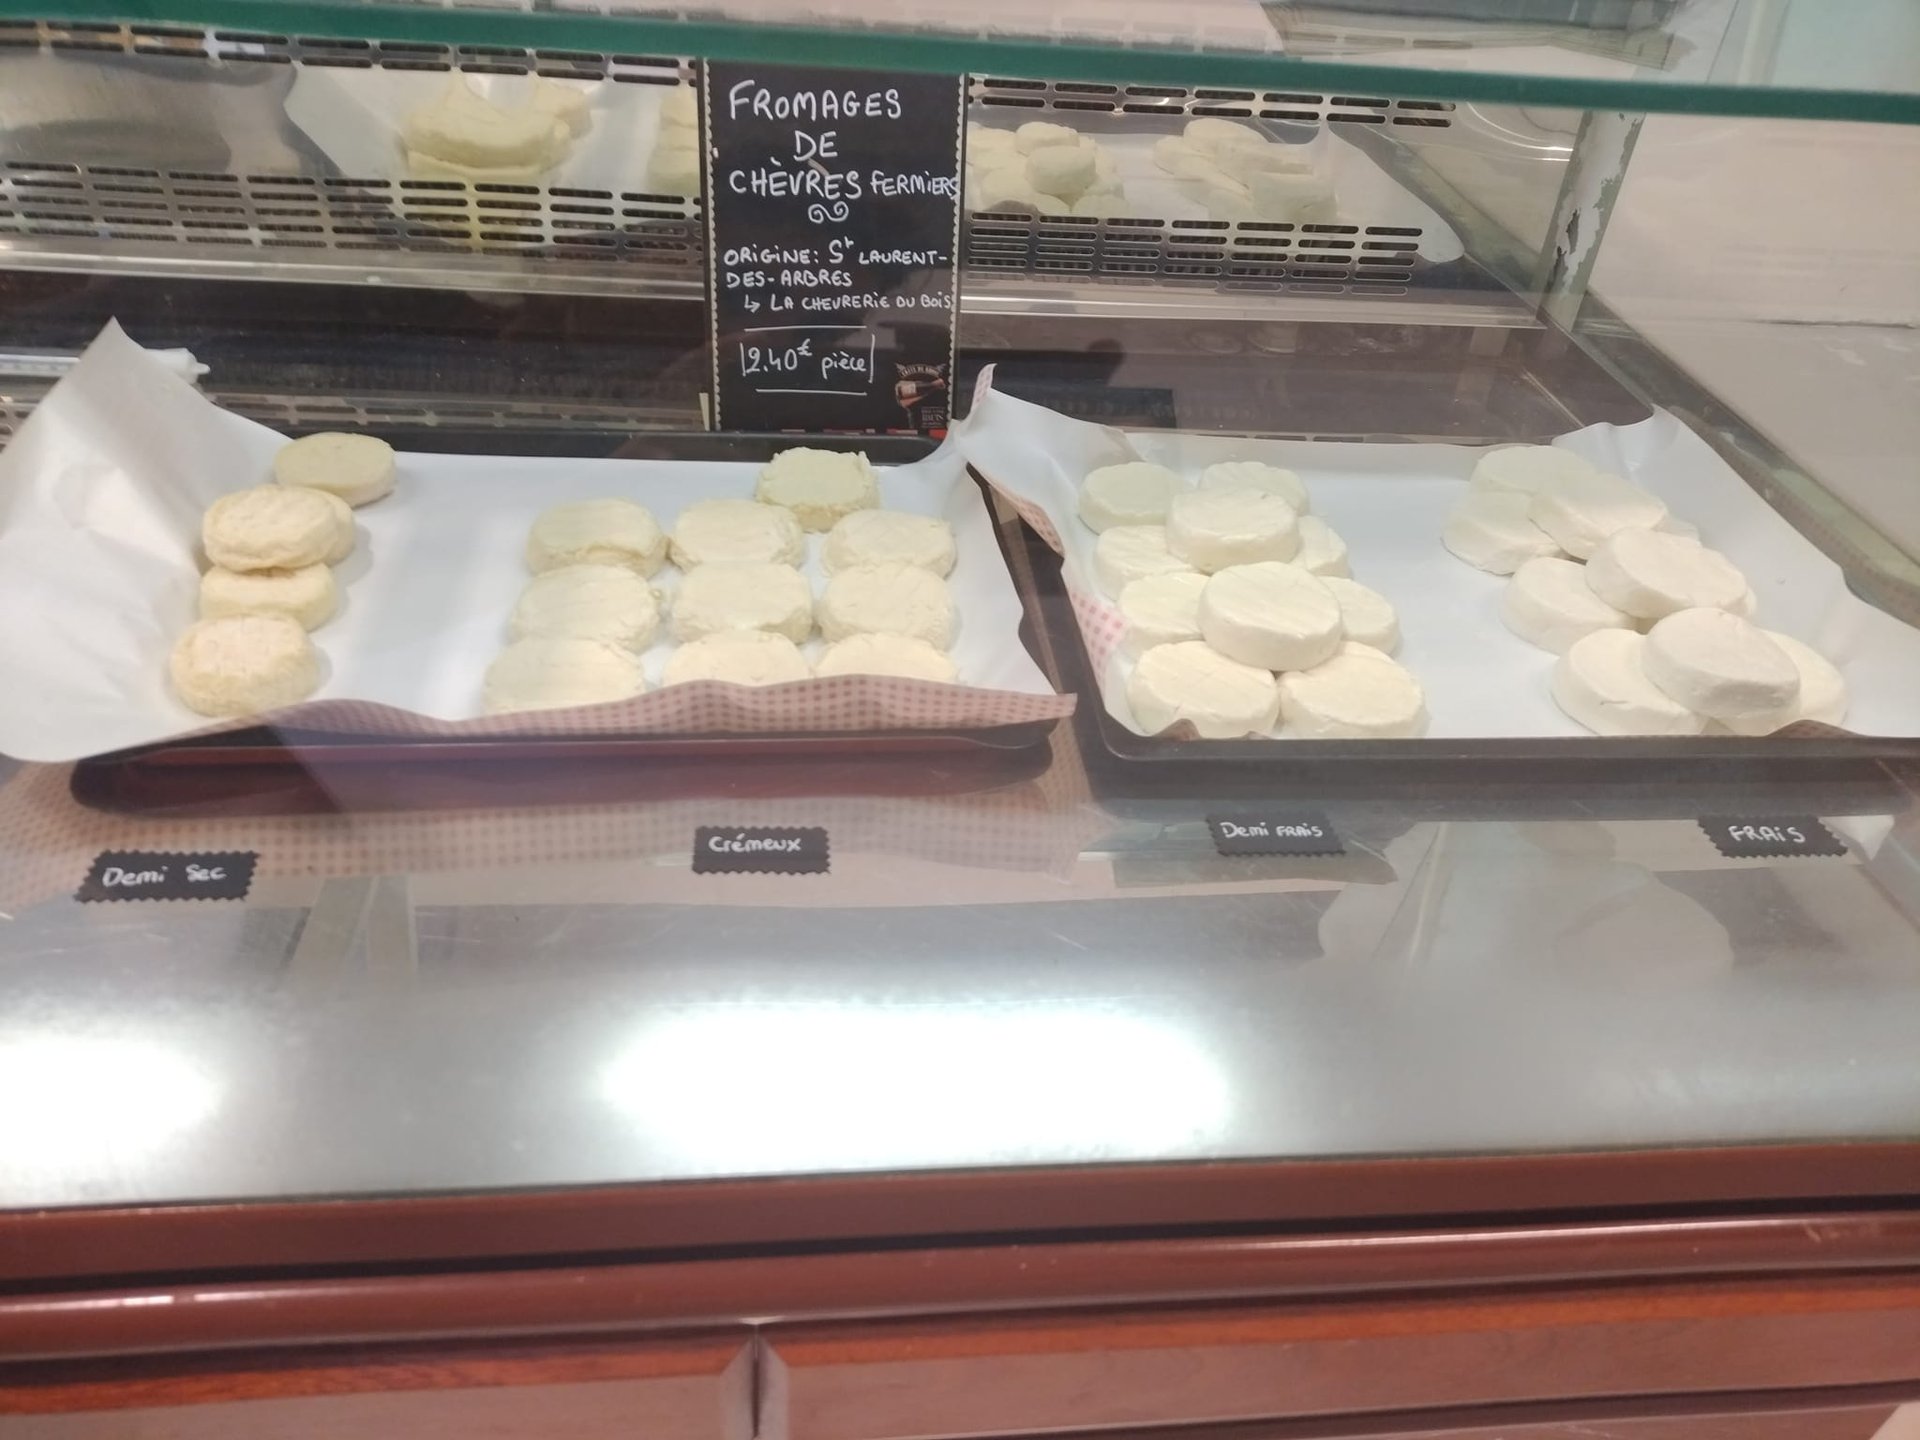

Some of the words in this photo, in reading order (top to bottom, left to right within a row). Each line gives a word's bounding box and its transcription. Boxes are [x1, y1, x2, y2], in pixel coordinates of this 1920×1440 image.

[729, 79, 902, 121] FROMAGES
[792, 130, 839, 162] DE
[729, 156, 862, 200] CHÈVRES
[858, 249, 948, 266] LAURENT-
[769, 294, 794, 311] LA
[895, 296, 916, 309] DU
[821, 351, 868, 380] pièce
[1219, 821, 1270, 838] Demi
[708, 833, 802, 853] Crémeux
[102, 865, 169, 887] Demi
[185, 863, 227, 883] Sec
